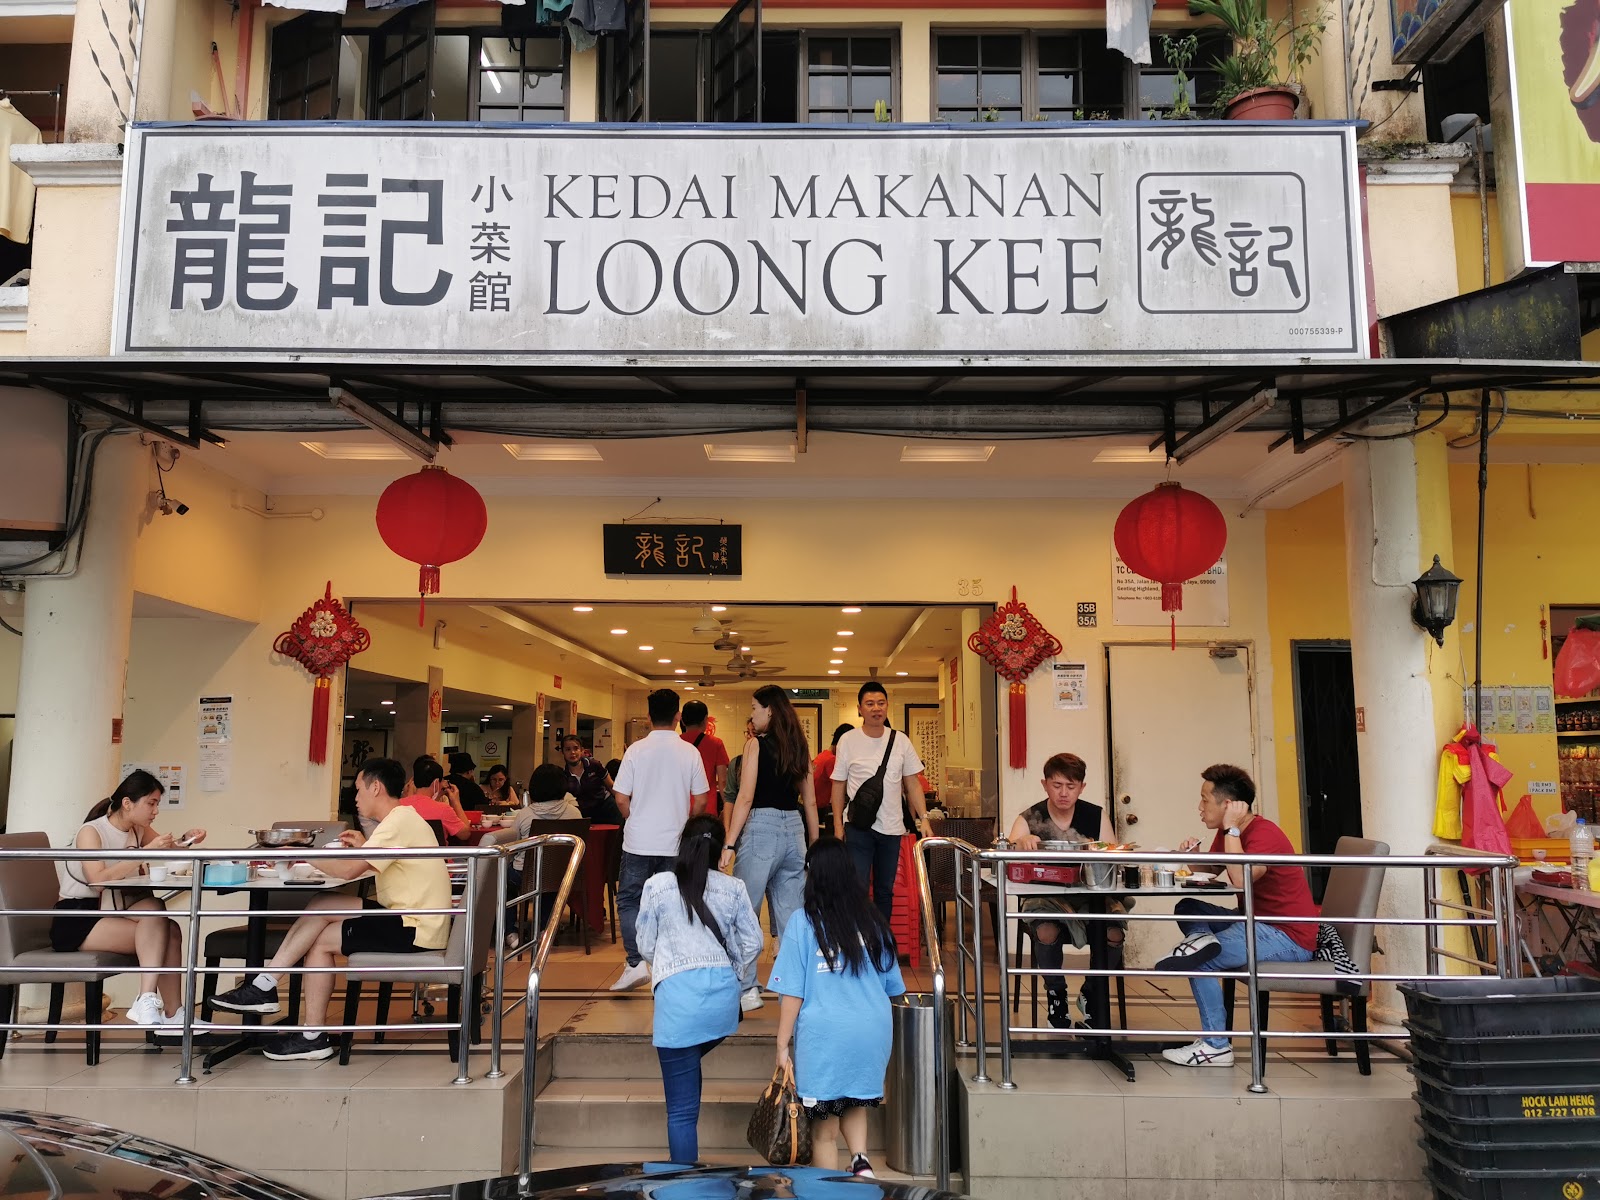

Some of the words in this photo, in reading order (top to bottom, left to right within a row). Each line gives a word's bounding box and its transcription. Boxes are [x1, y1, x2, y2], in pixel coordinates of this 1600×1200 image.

[544, 174, 738, 219] KEDAI
[770, 173, 1103, 218] MAKANAN
[167, 171, 453, 311] 龍記
[470, 176, 514, 312] 小菜館
[1147, 189, 1300, 298] 龍記
[543, 238, 887, 316] LOONG
[934, 238, 1108, 315] KEE
[1289, 327, 1343, 335] 000755339-P
[634, 532, 706, 569] 龍記
[958, 578, 984, 596] 35
[1078, 604, 1095, 613] 35B
[1078, 616, 1096, 626] 35A
[1522, 1096, 1547, 1108] HOCK
[1548, 1096, 1568, 1106] LAM
[1570, 1094, 1595, 1106] HENG
[1524, 1109, 1542, 1117] 012
[1571, 1108, 1596, 1116] 1078
